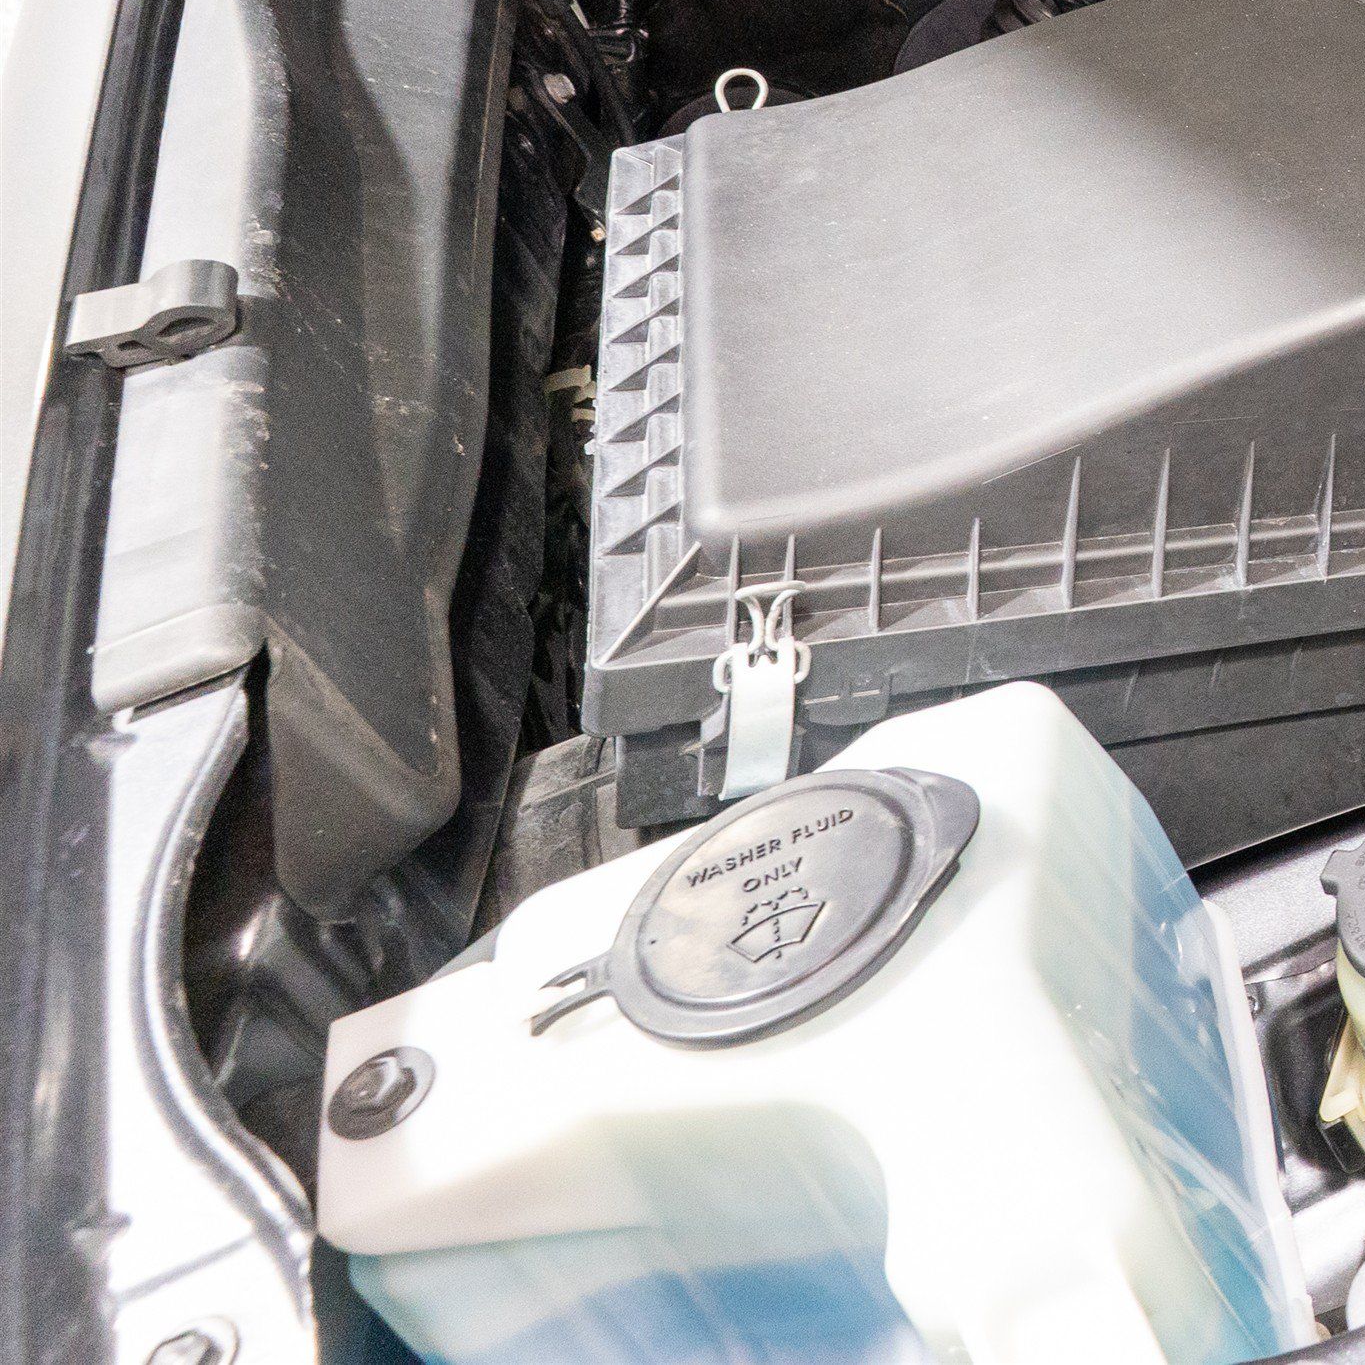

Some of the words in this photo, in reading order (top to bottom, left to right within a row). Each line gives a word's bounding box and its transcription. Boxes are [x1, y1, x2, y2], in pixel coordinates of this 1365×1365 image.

[686, 838, 782, 888] WASHER
[791, 807, 854, 843] FLUID
[742, 856, 804, 893] ONLY
